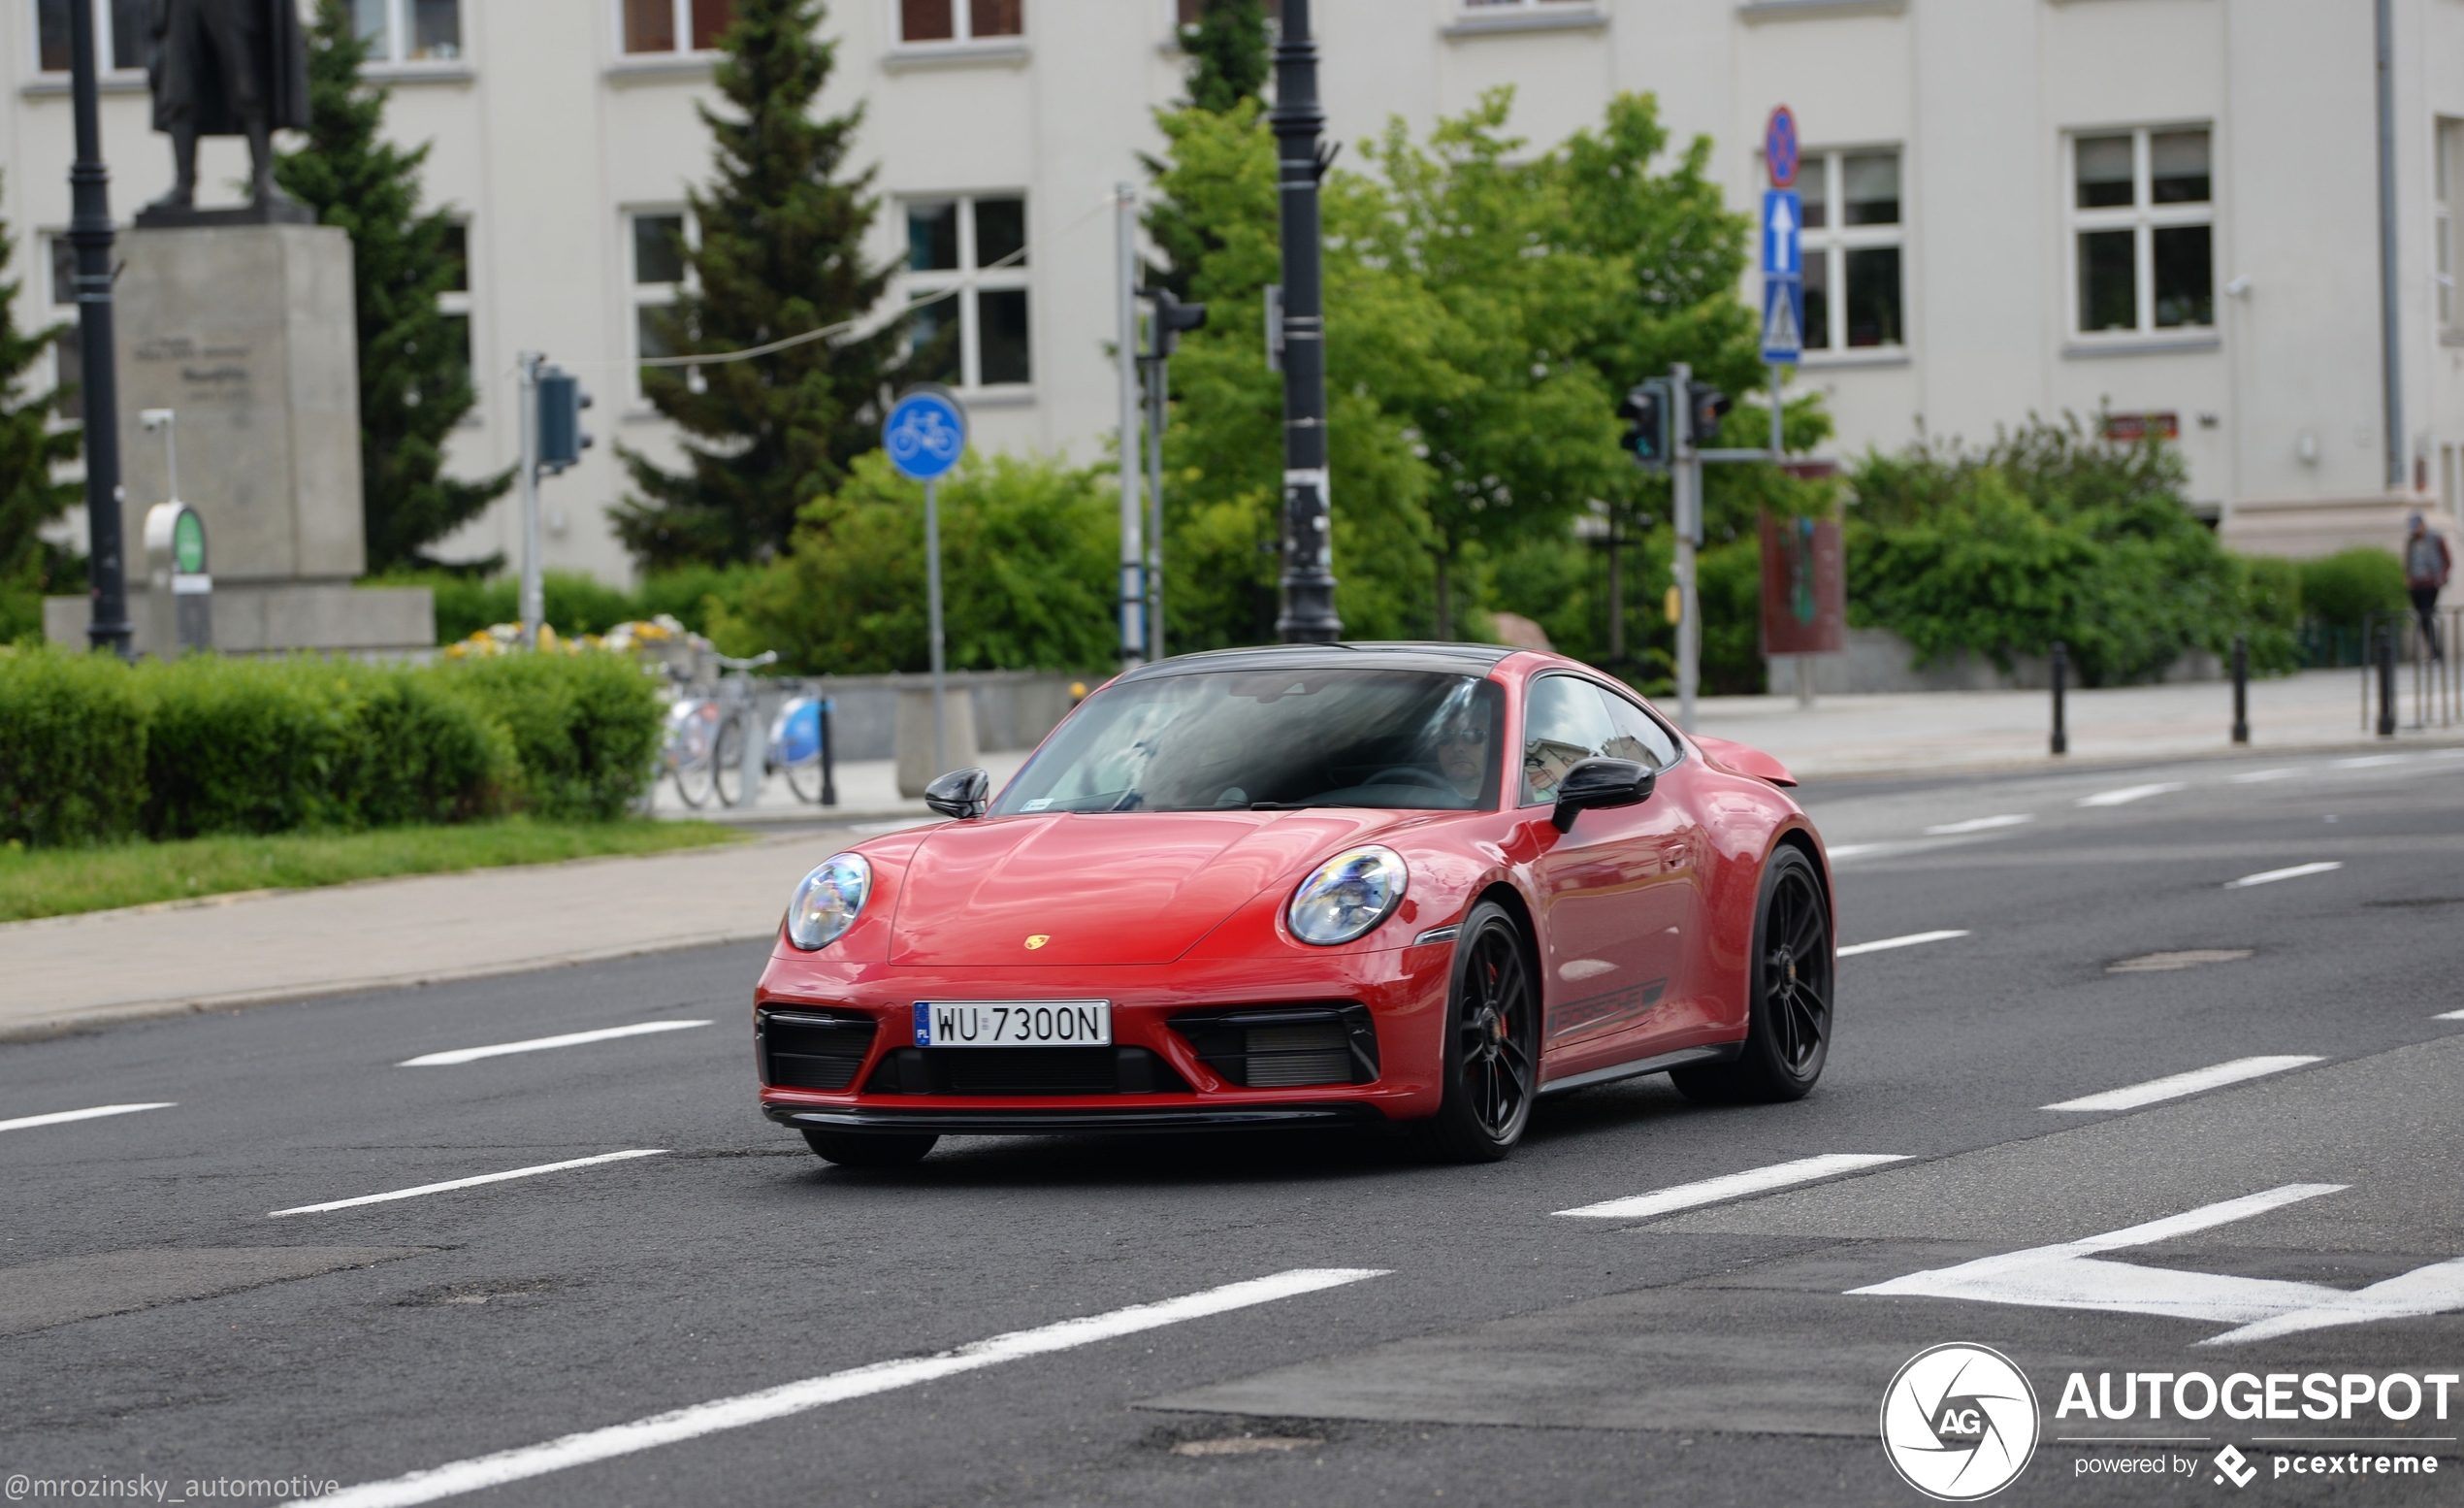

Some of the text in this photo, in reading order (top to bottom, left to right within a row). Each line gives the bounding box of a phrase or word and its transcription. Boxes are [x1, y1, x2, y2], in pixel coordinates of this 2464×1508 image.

[937, 1006, 1098, 1041] WU 7300N
[1558, 992, 1639, 1028] PORSCHE
[917, 1029, 929, 1038] PL
